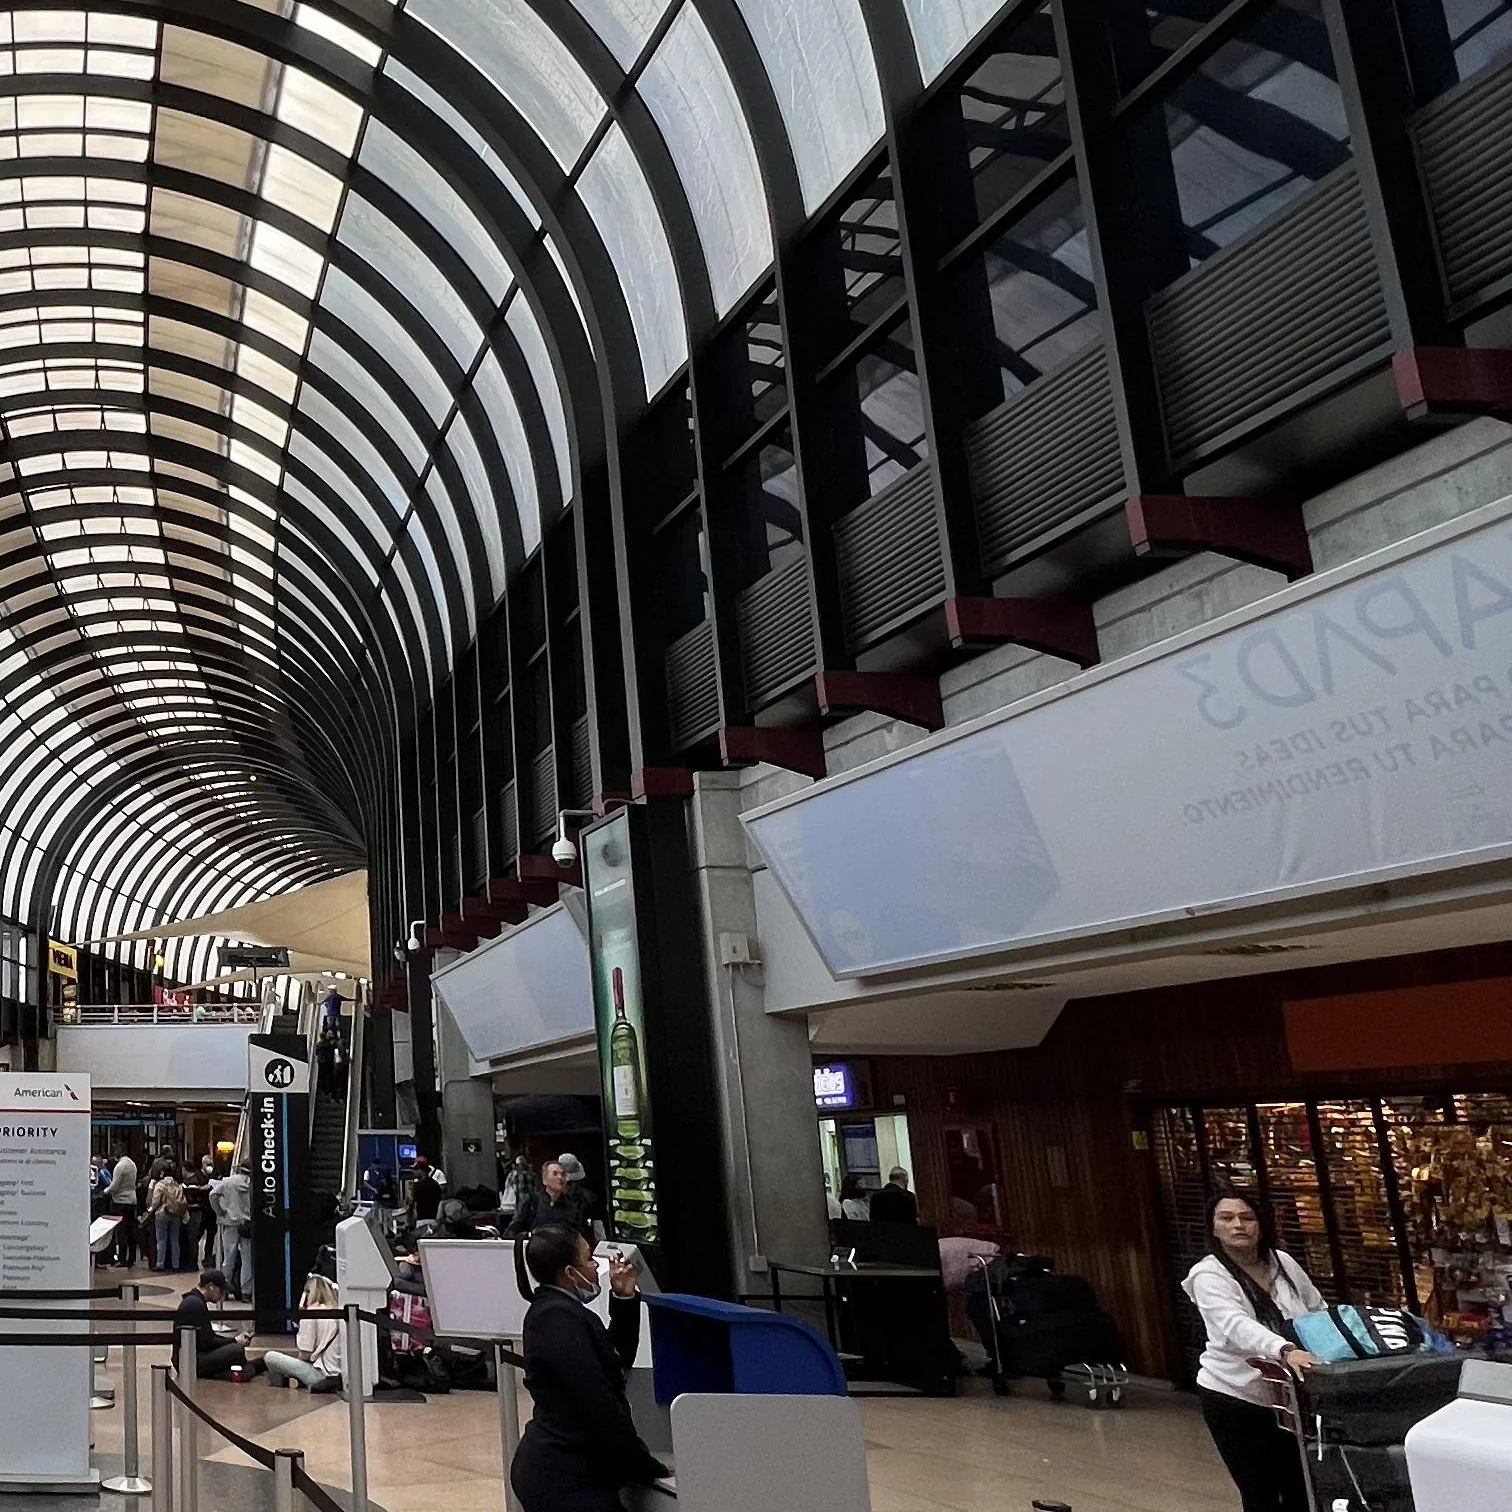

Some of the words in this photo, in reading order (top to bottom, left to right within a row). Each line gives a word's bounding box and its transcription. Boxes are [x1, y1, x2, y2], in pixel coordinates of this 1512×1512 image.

[14, 1087, 63, 1098] American
[260, 1096, 276, 1173] Check-in
[262, 1176, 276, 1219] Auto
